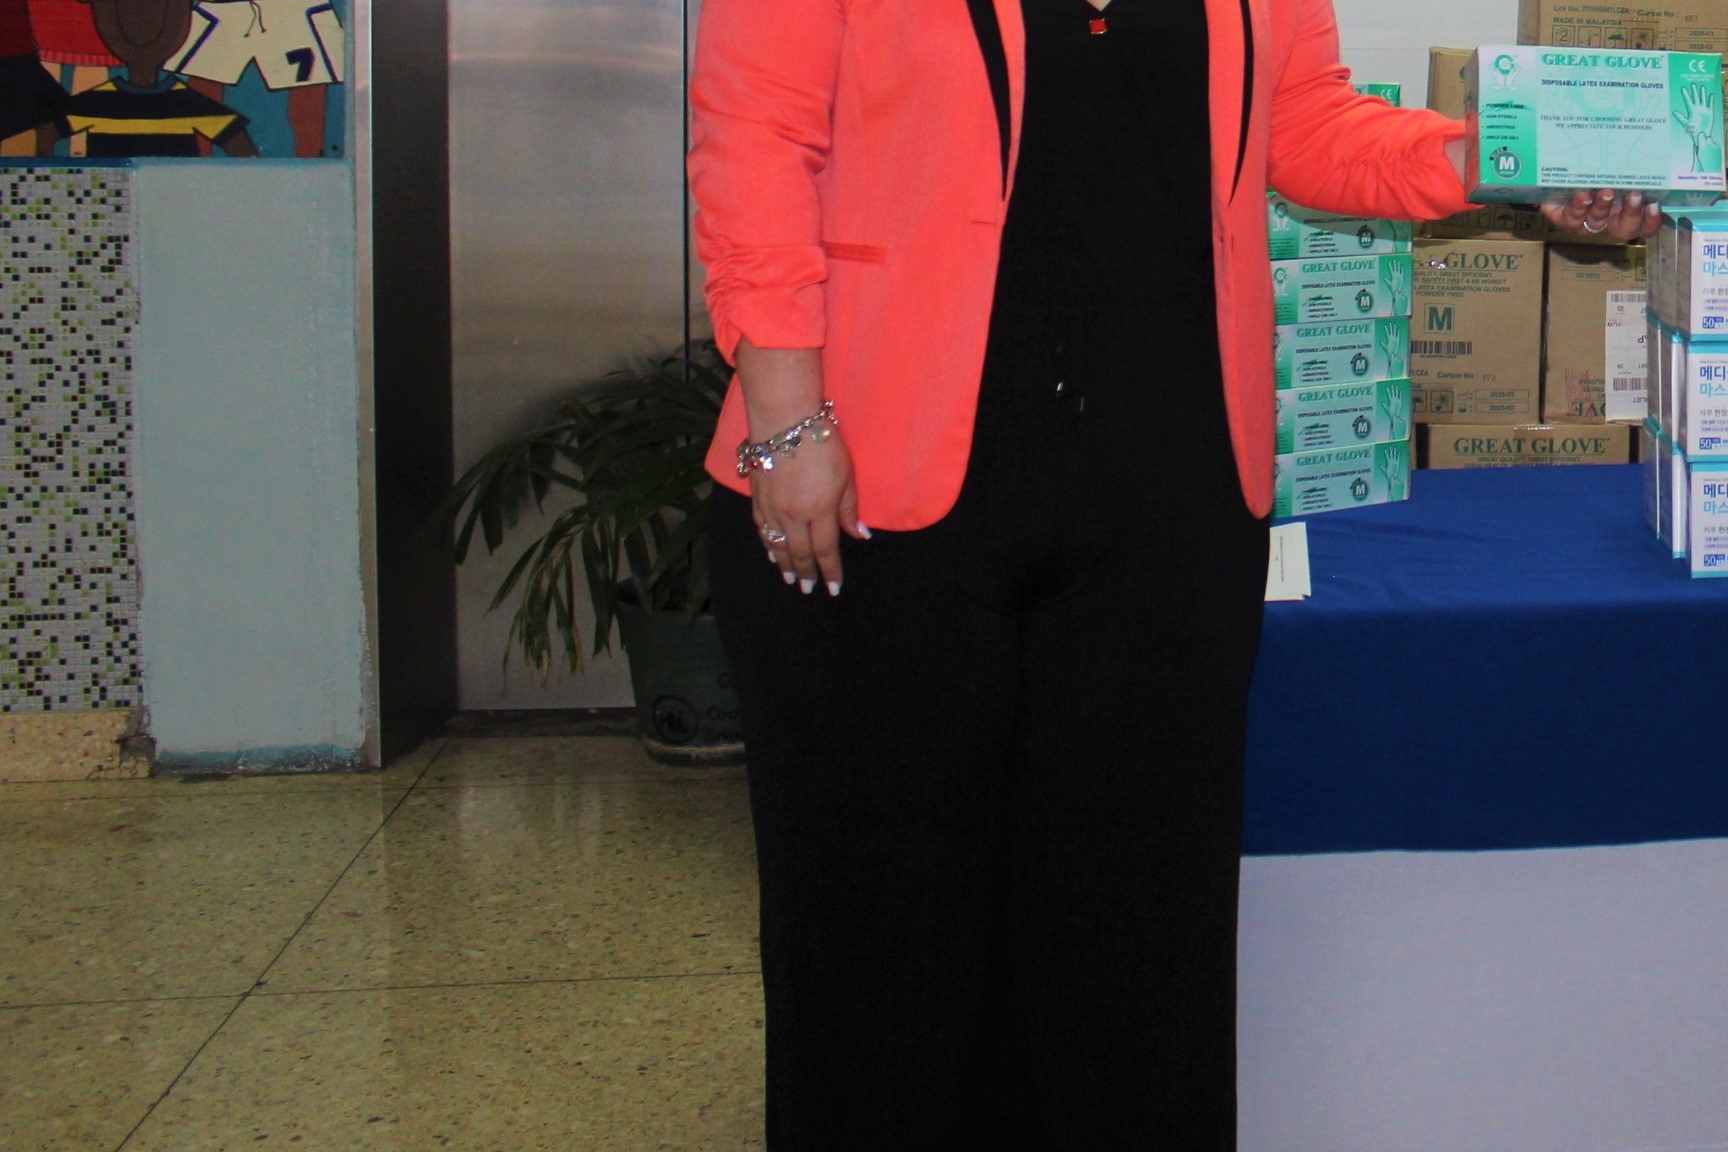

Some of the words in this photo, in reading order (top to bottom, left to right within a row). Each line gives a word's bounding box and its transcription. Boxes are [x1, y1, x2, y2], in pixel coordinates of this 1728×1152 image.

[1586, 18, 1622, 26] MALAYSIA
[1542, 53, 1600, 67] GREAT
[1601, 56, 1662, 69] GLOVE
[1499, 156, 1515, 170] M
[1302, 262, 1338, 274] GREAT
[1340, 260, 1375, 271] GLOVE
[1445, 252, 1518, 270] GLOVE
[1360, 296, 1370, 307] M
[1428, 307, 1452, 330] M
[1703, 318, 1714, 328] 50
[1296, 326, 1332, 338] GREAT
[1335, 323, 1371, 335] GLOVE
[1355, 360, 1365, 371] M
[1298, 390, 1334, 403] GREAT
[1337, 386, 1372, 399] GLOVE
[1357, 422, 1367, 433] M
[1454, 438, 1526, 454] GREAT
[1531, 438, 1605, 454] GLOVE
[1700, 438, 1712, 449] 50
[1296, 453, 1333, 467] GREAT
[1335, 449, 1371, 462] GLOVE
[1355, 484, 1365, 496] M
[1704, 555, 1715, 566] 50
